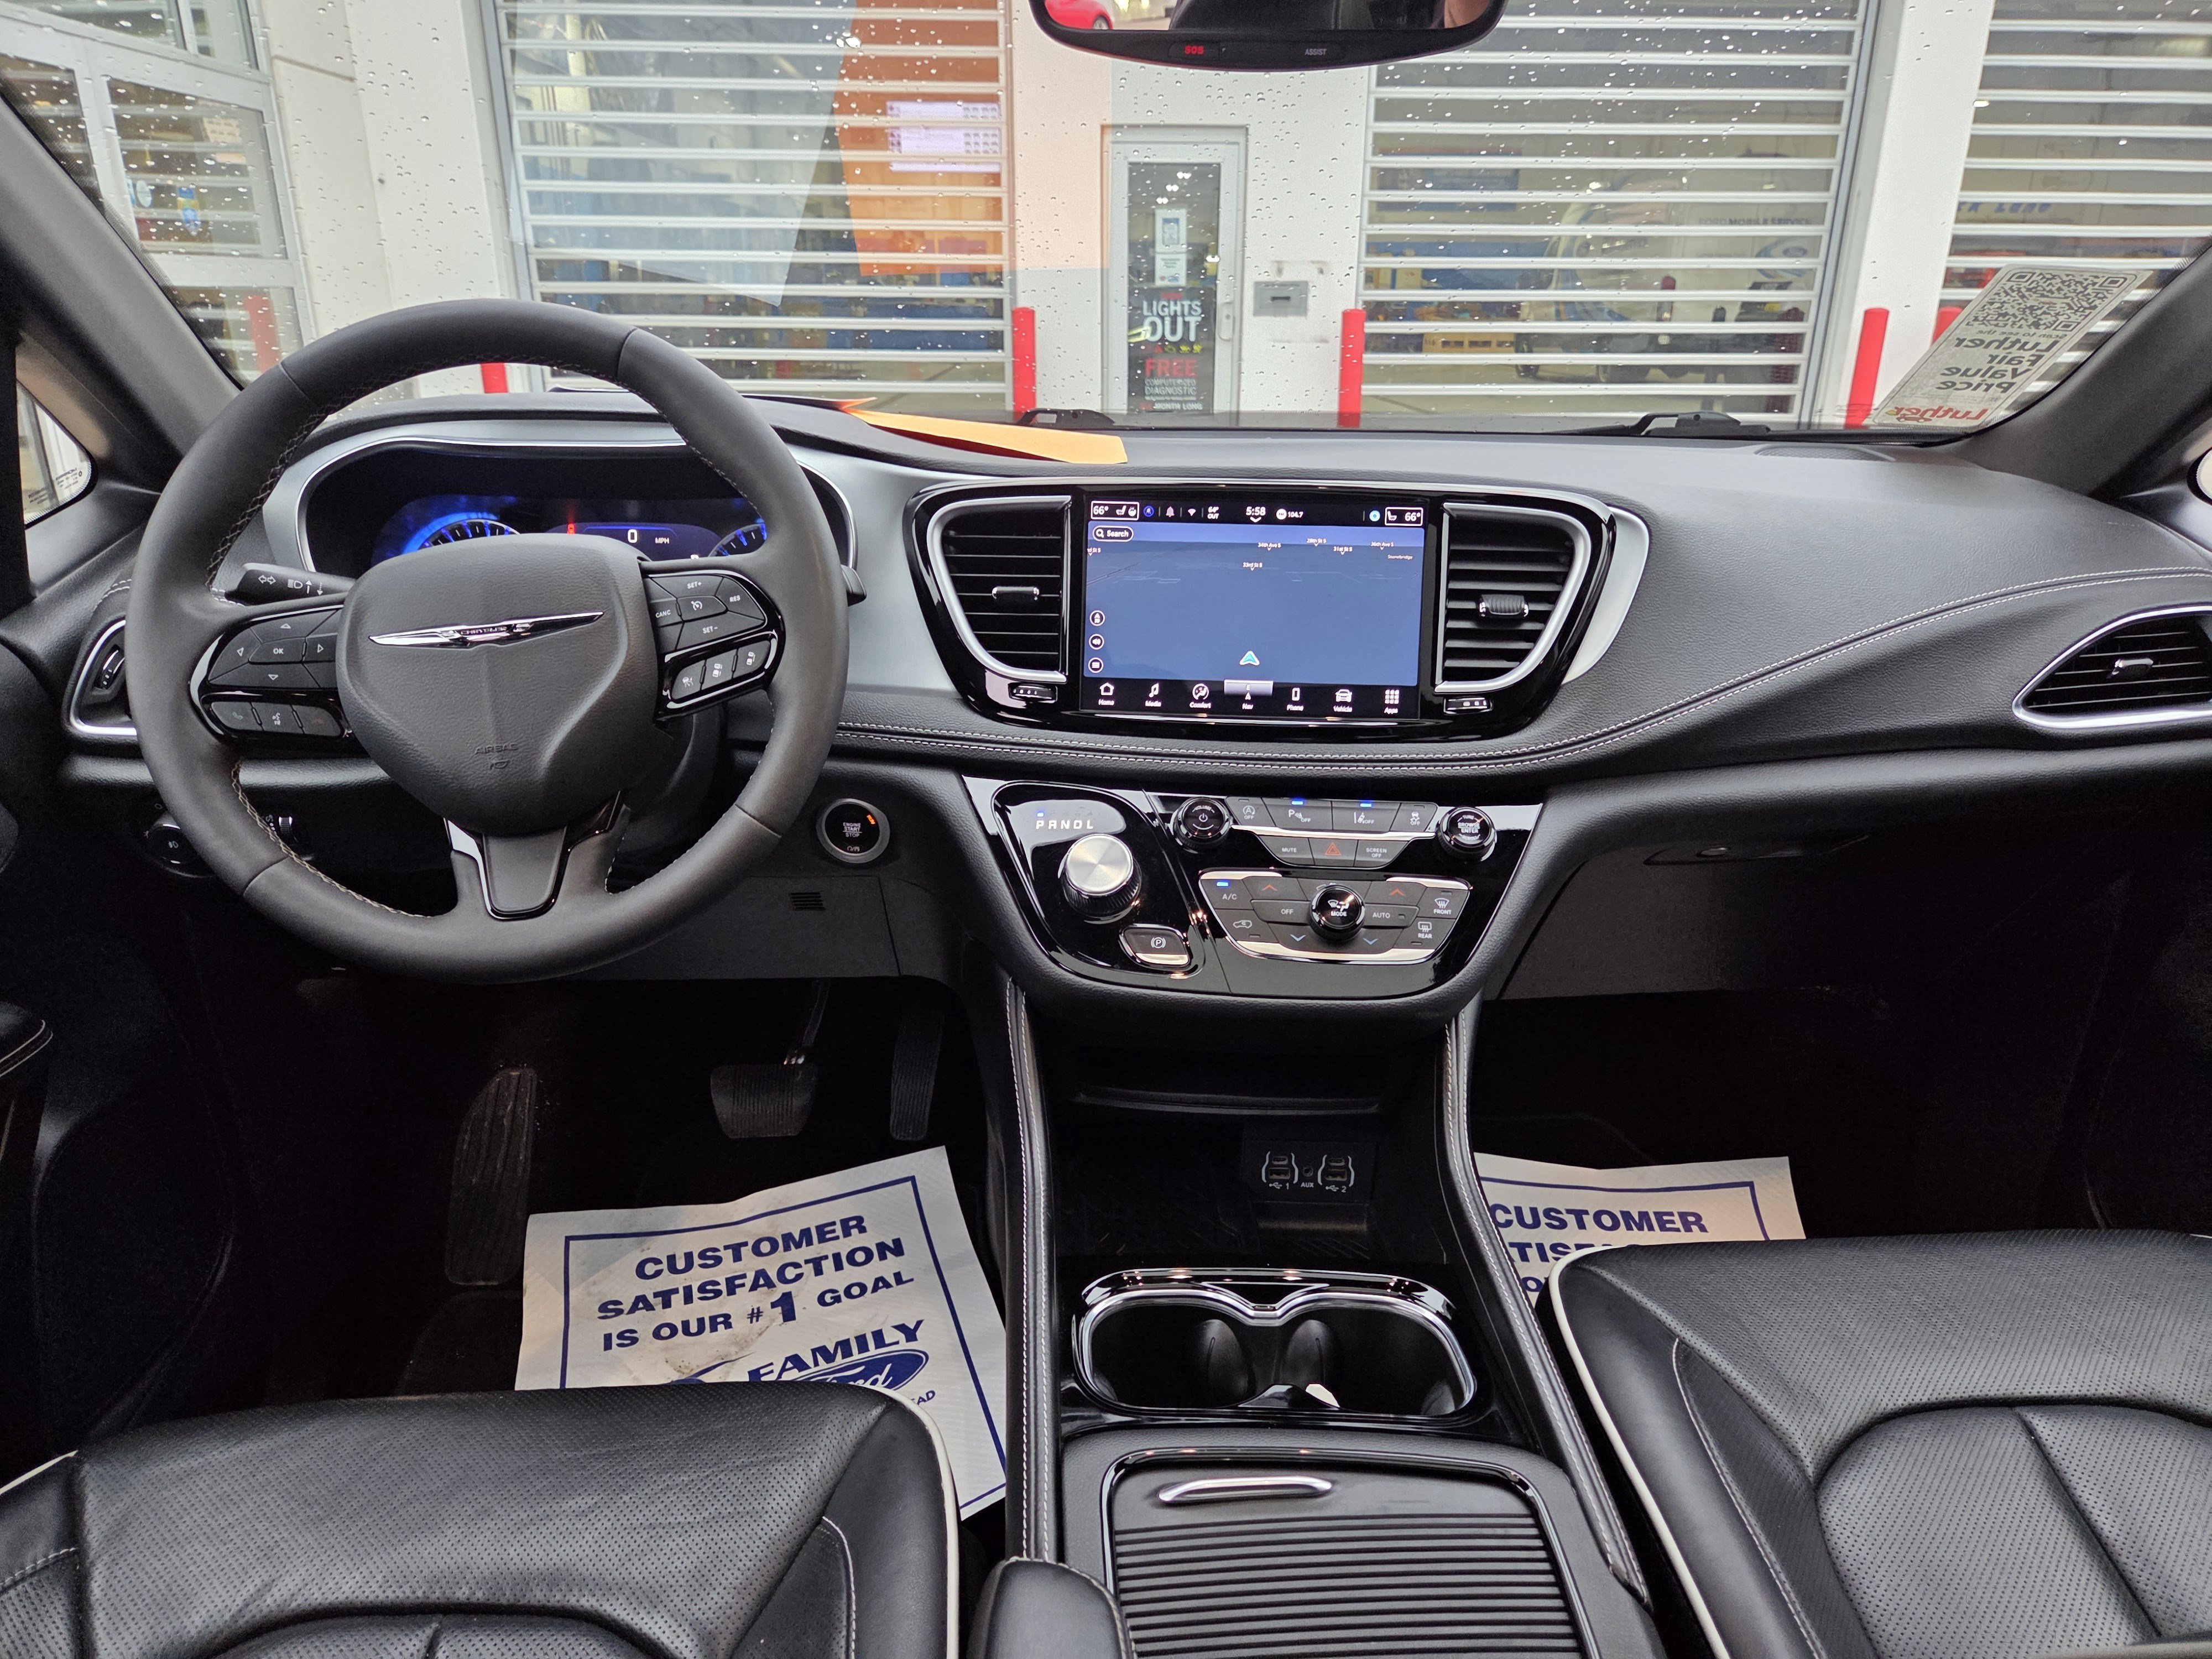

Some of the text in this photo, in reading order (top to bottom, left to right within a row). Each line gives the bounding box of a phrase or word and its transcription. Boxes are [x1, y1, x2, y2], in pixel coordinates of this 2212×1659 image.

[1185, 45, 1204, 55] SOS
[1305, 48, 1327, 56] ASSIST
[1142, 300, 1202, 316] LIGHTS
[1142, 316, 1202, 342] OUT
[1145, 358, 1197, 377] FREE
[1145, 386, 1197, 395] DIAGNOSTIC
[1093, 505, 1109, 515] 66°
[1246, 507, 1266, 515] 5:58
[1405, 512, 1421, 521] 66°
[627, 529, 638, 543] 0
[655, 609, 671, 618] CANC
[1490, 1203, 1709, 1234] CUSTOMER
[635, 1215, 868, 1281] CUSTOMER
[597, 1237, 905, 1321] SATISFACTION
[603, 1328, 640, 1352] IS
[652, 1312, 733, 1342] OUR
[816, 1270, 915, 1308] GOAL
[747, 1319, 925, 1381] FAMILY
